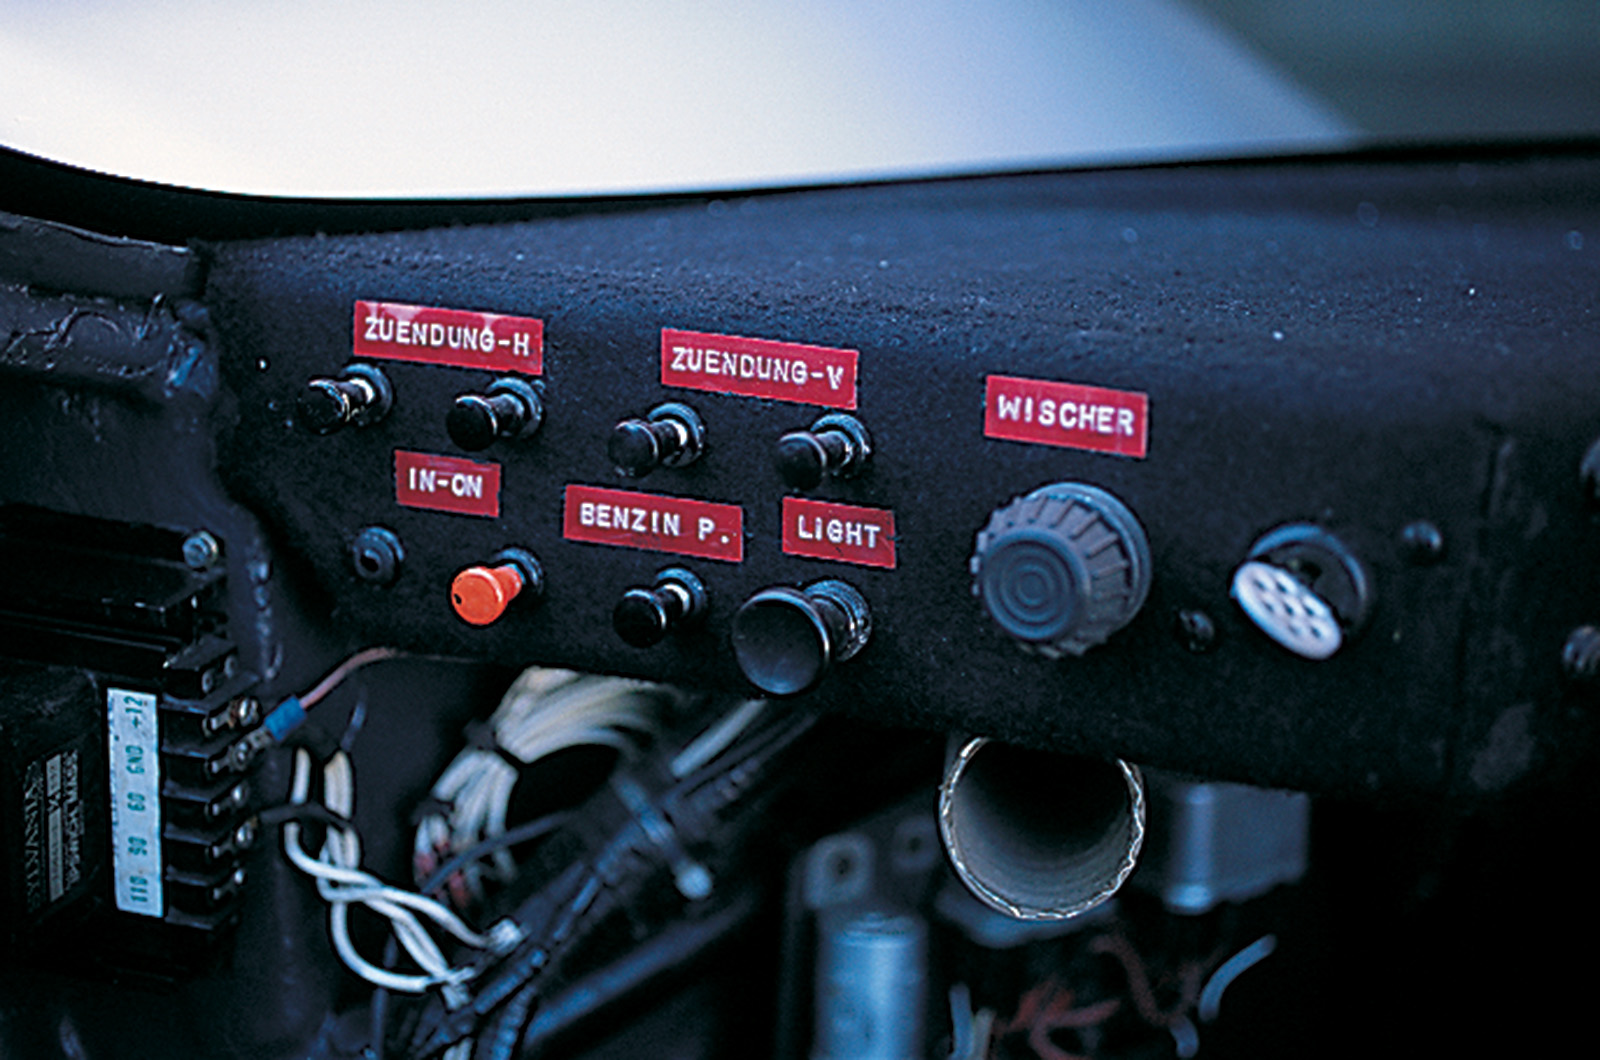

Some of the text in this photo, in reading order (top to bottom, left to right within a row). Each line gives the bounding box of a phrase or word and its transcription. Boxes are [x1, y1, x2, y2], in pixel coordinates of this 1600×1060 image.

[363, 316, 530, 357] ZUENDUNG-H
[670, 346, 844, 390] ZUENDUNG-V
[997, 394, 1135, 436] WISCHER
[408, 467, 483, 498] IN-ON
[579, 502, 730, 544] BENZIN P.
[125, 745, 145, 775] GND
